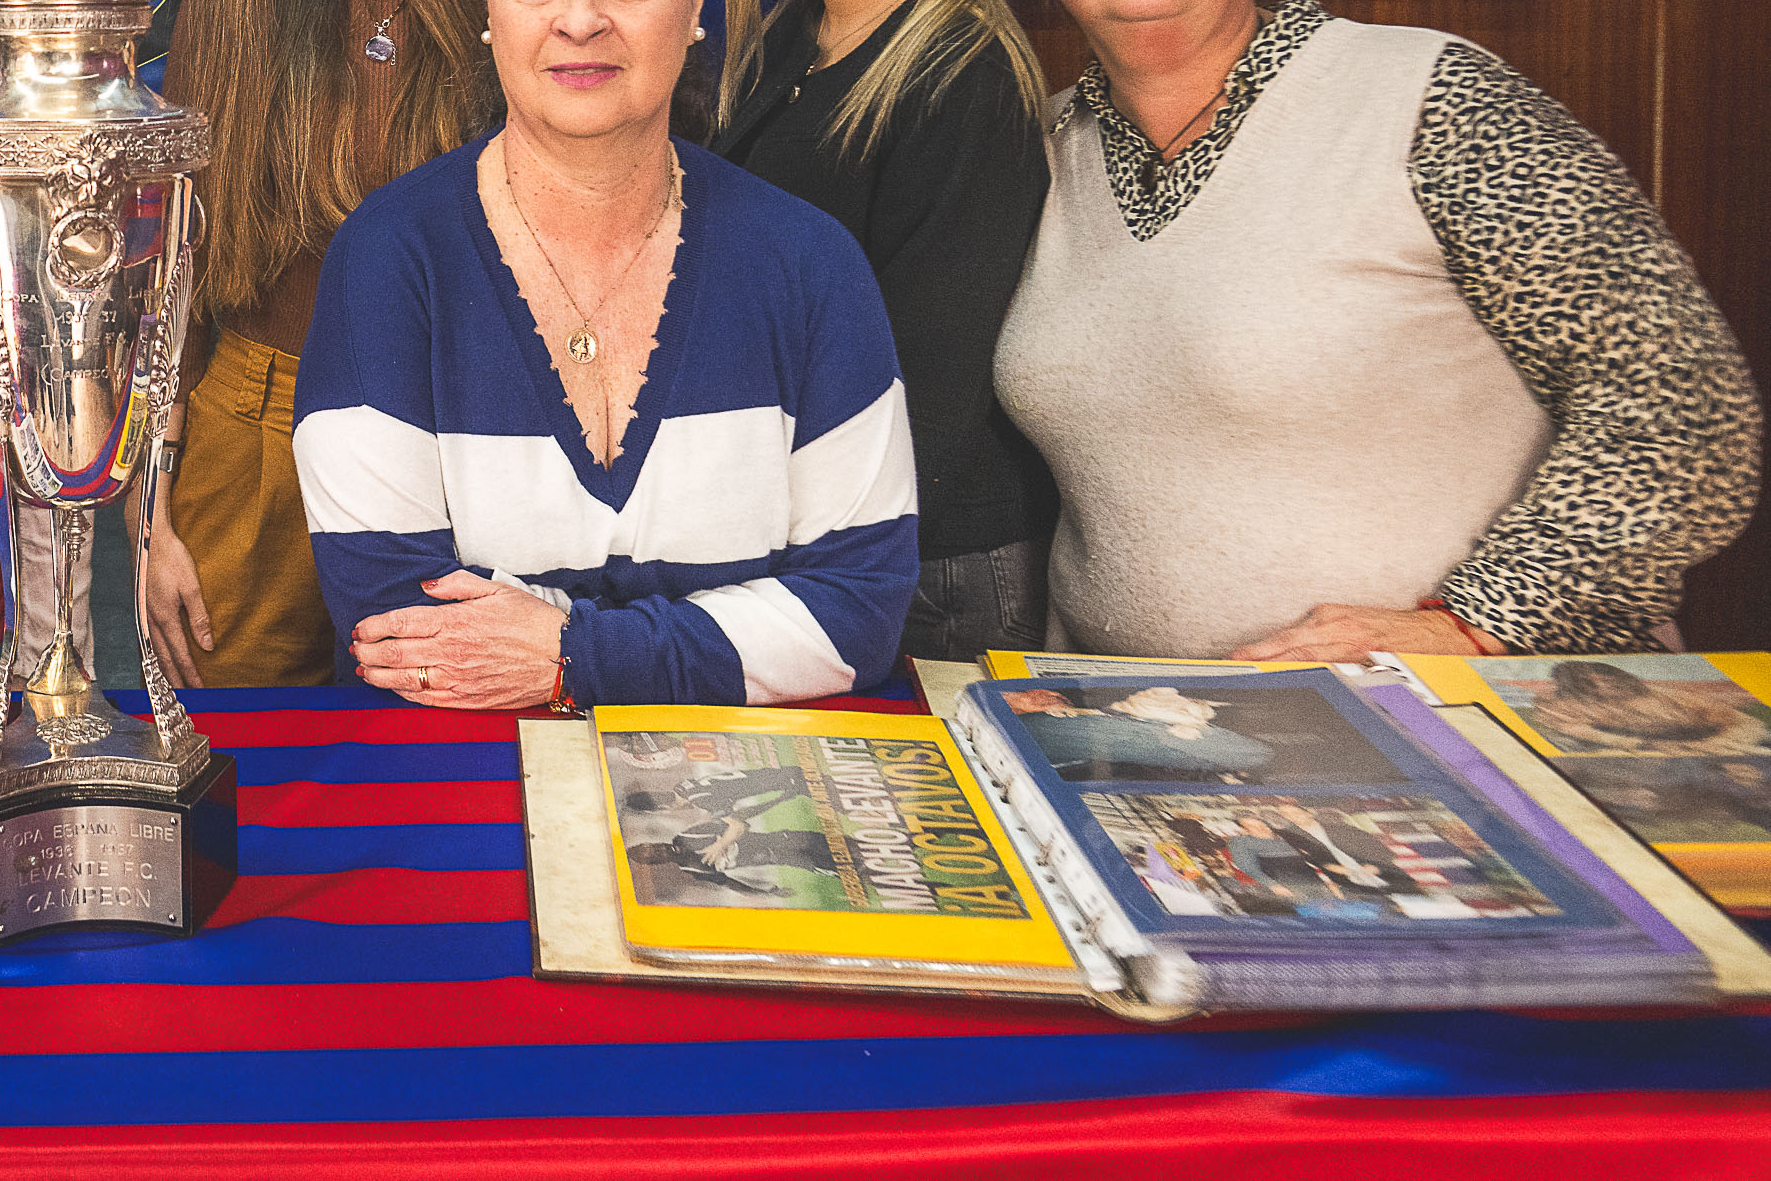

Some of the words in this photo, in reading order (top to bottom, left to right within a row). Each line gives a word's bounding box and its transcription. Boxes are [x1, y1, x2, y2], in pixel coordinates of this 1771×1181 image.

[818, 737, 901, 829] LEVANTE
[869, 740, 1000, 875] OCTAVOS!
[2, 828, 43, 852] COPA
[130, 823, 175, 843] LIBRE
[19, 860, 110, 887] LEVANTE
[123, 861, 158, 881] F.C.
[853, 829, 939, 911] MACHO
[27, 885, 152, 914] CAMPEON
[934, 884, 1025, 917] ¡A
